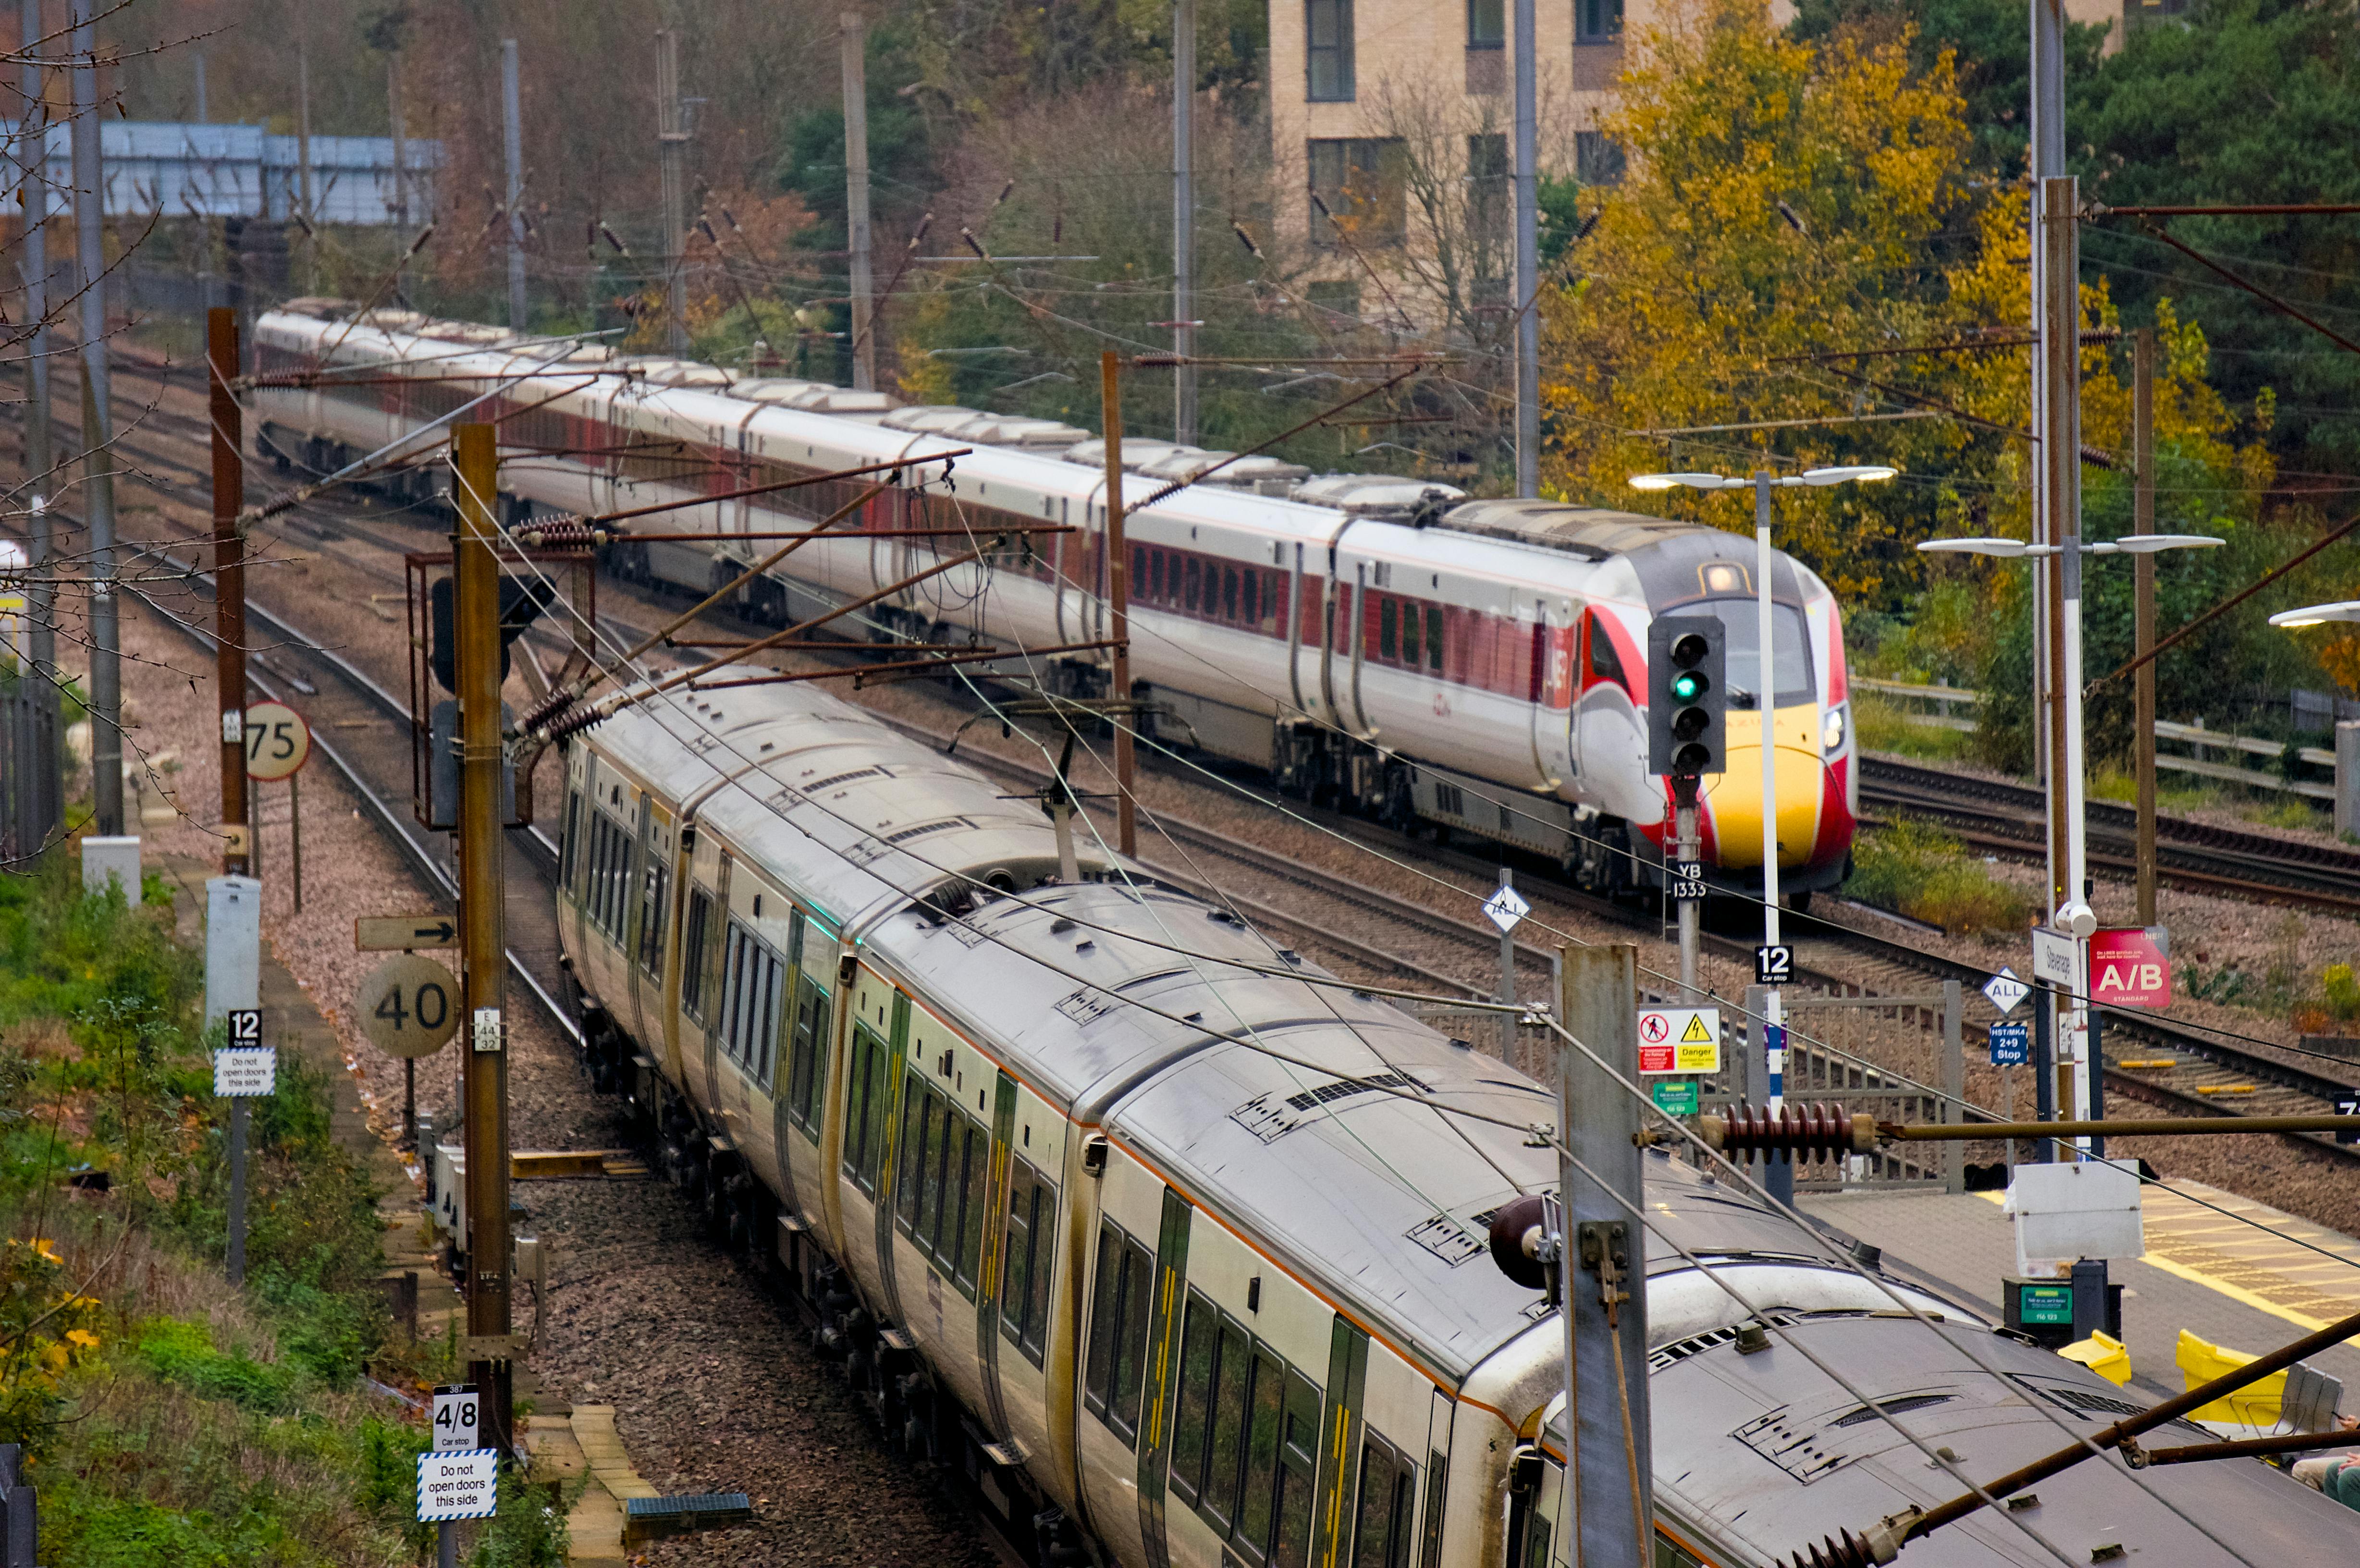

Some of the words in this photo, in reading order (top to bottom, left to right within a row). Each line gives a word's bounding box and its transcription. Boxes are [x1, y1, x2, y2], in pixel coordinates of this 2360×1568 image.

[246, 722, 295, 760] 75
[1679, 864, 1701, 879] YB
[1674, 881, 1706, 898] 1333
[1759, 947, 1789, 973] 12
[2047, 945, 2070, 980] Stevenage
[2099, 964, 2163, 992] A/B
[1992, 985, 2021, 996] ALL
[375, 982, 446, 1030] 40
[484, 1013, 490, 1021] E
[232, 1012, 258, 1038] 12
[481, 1040, 495, 1049] 32
[2000, 1038, 2018, 1048] 2+9
[1683, 1049, 1711, 1057] Danger
[1998, 1050, 2021, 1060] Stop
[435, 1401, 476, 1433] 4/8
[441, 1466, 455, 1476] Do
[457, 1464, 473, 1475] not
[429, 1482, 454, 1494] open
[456, 1480, 485, 1490] doors
[436, 1495, 454, 1507] this
[457, 1494, 478, 1505] side
